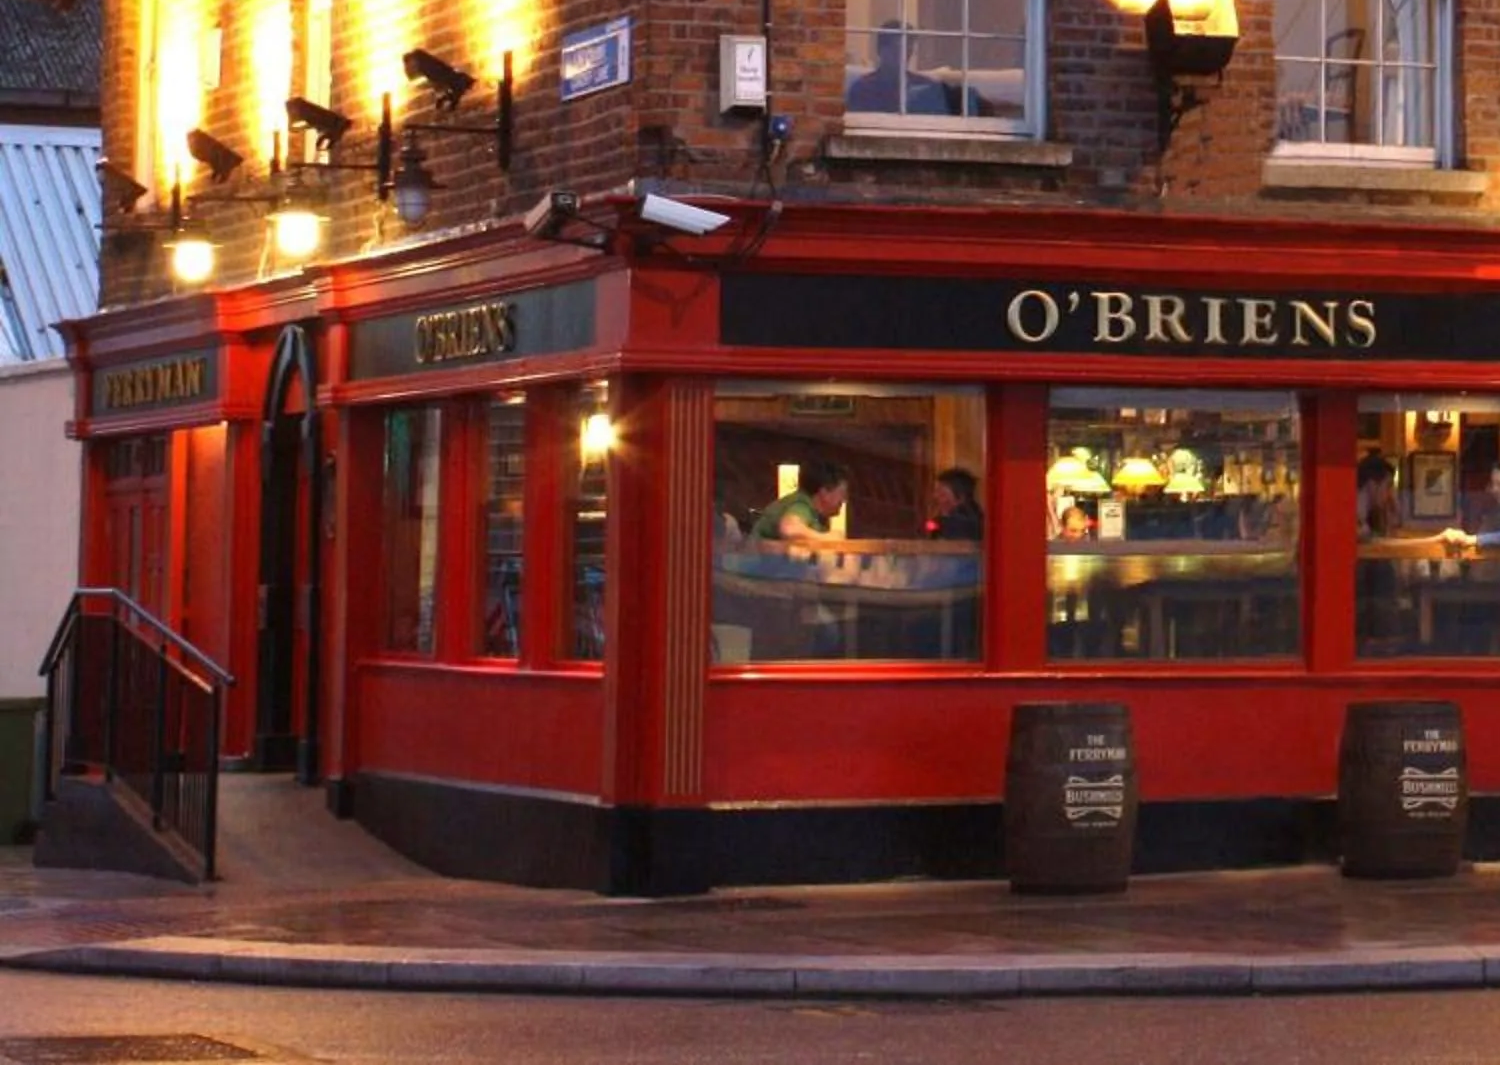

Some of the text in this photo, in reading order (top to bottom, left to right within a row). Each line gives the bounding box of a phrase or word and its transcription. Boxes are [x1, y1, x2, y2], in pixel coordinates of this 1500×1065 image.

[416, 302, 515, 363] O'BRIENS
[1006, 289, 1378, 349] O'BRIENS
[103, 359, 201, 409] FERRYMAN
